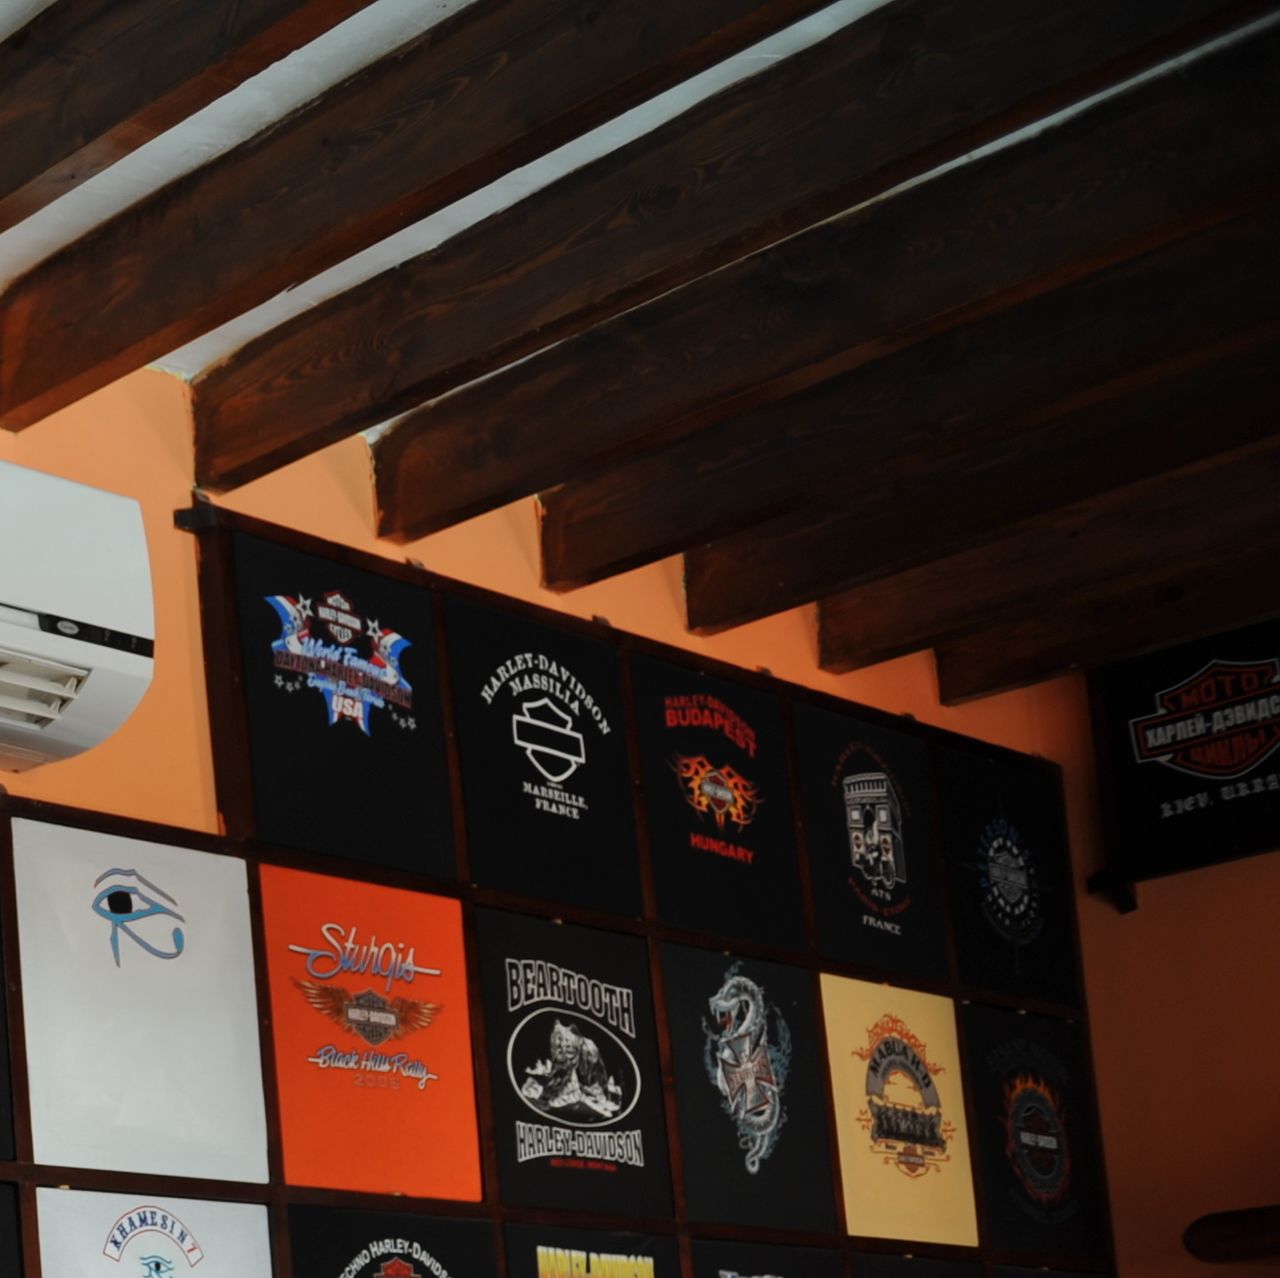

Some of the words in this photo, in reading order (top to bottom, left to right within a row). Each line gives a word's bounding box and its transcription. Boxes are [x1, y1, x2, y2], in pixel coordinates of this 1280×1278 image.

[331, 695, 364, 718] USA
[481, 653, 611, 735] HARLEY-DAVIDSON
[509, 673, 580, 716] MASSILIA
[665, 708, 758, 759] BUDAPEST
[535, 798, 580, 819] FRANCE
[690, 832, 754, 864] HUNGARY
[862, 914, 902, 936] FRANCE
[288, 923, 442, 992] Sturgis
[505, 958, 636, 1038] BEARTOOTH
[307, 1045, 359, 1070] Black
[391, 1053, 439, 1089] Rally
[515, 1120, 644, 1168] HARLEY-DAVIDSON
[110, 1210, 188, 1251] KHAMESIN
